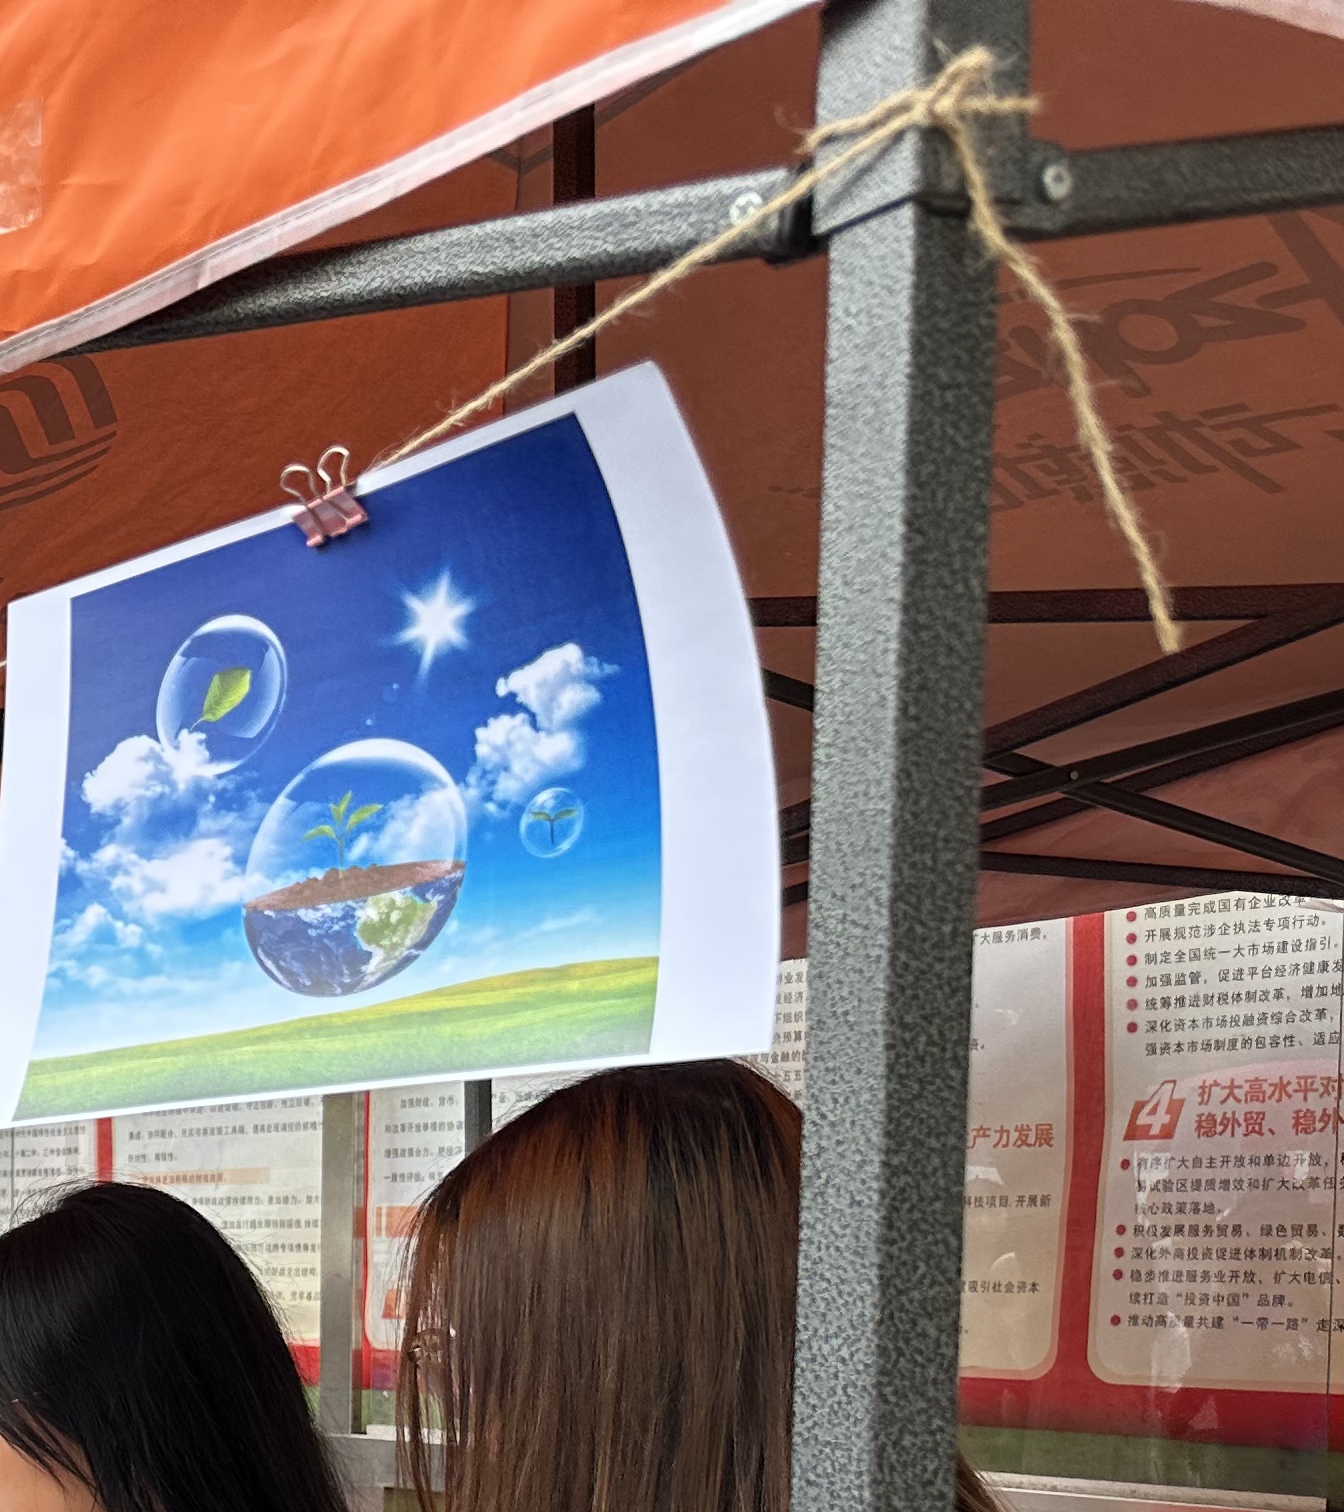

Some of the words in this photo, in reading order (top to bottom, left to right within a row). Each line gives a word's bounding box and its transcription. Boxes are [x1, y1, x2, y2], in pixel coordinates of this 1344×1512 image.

[1136, 1079, 1178, 1136] 4
[967, 1123, 1055, 1150] 产力发展
[1137, 1151, 1344, 1171] 有序扩大自主开放和单边开放,
